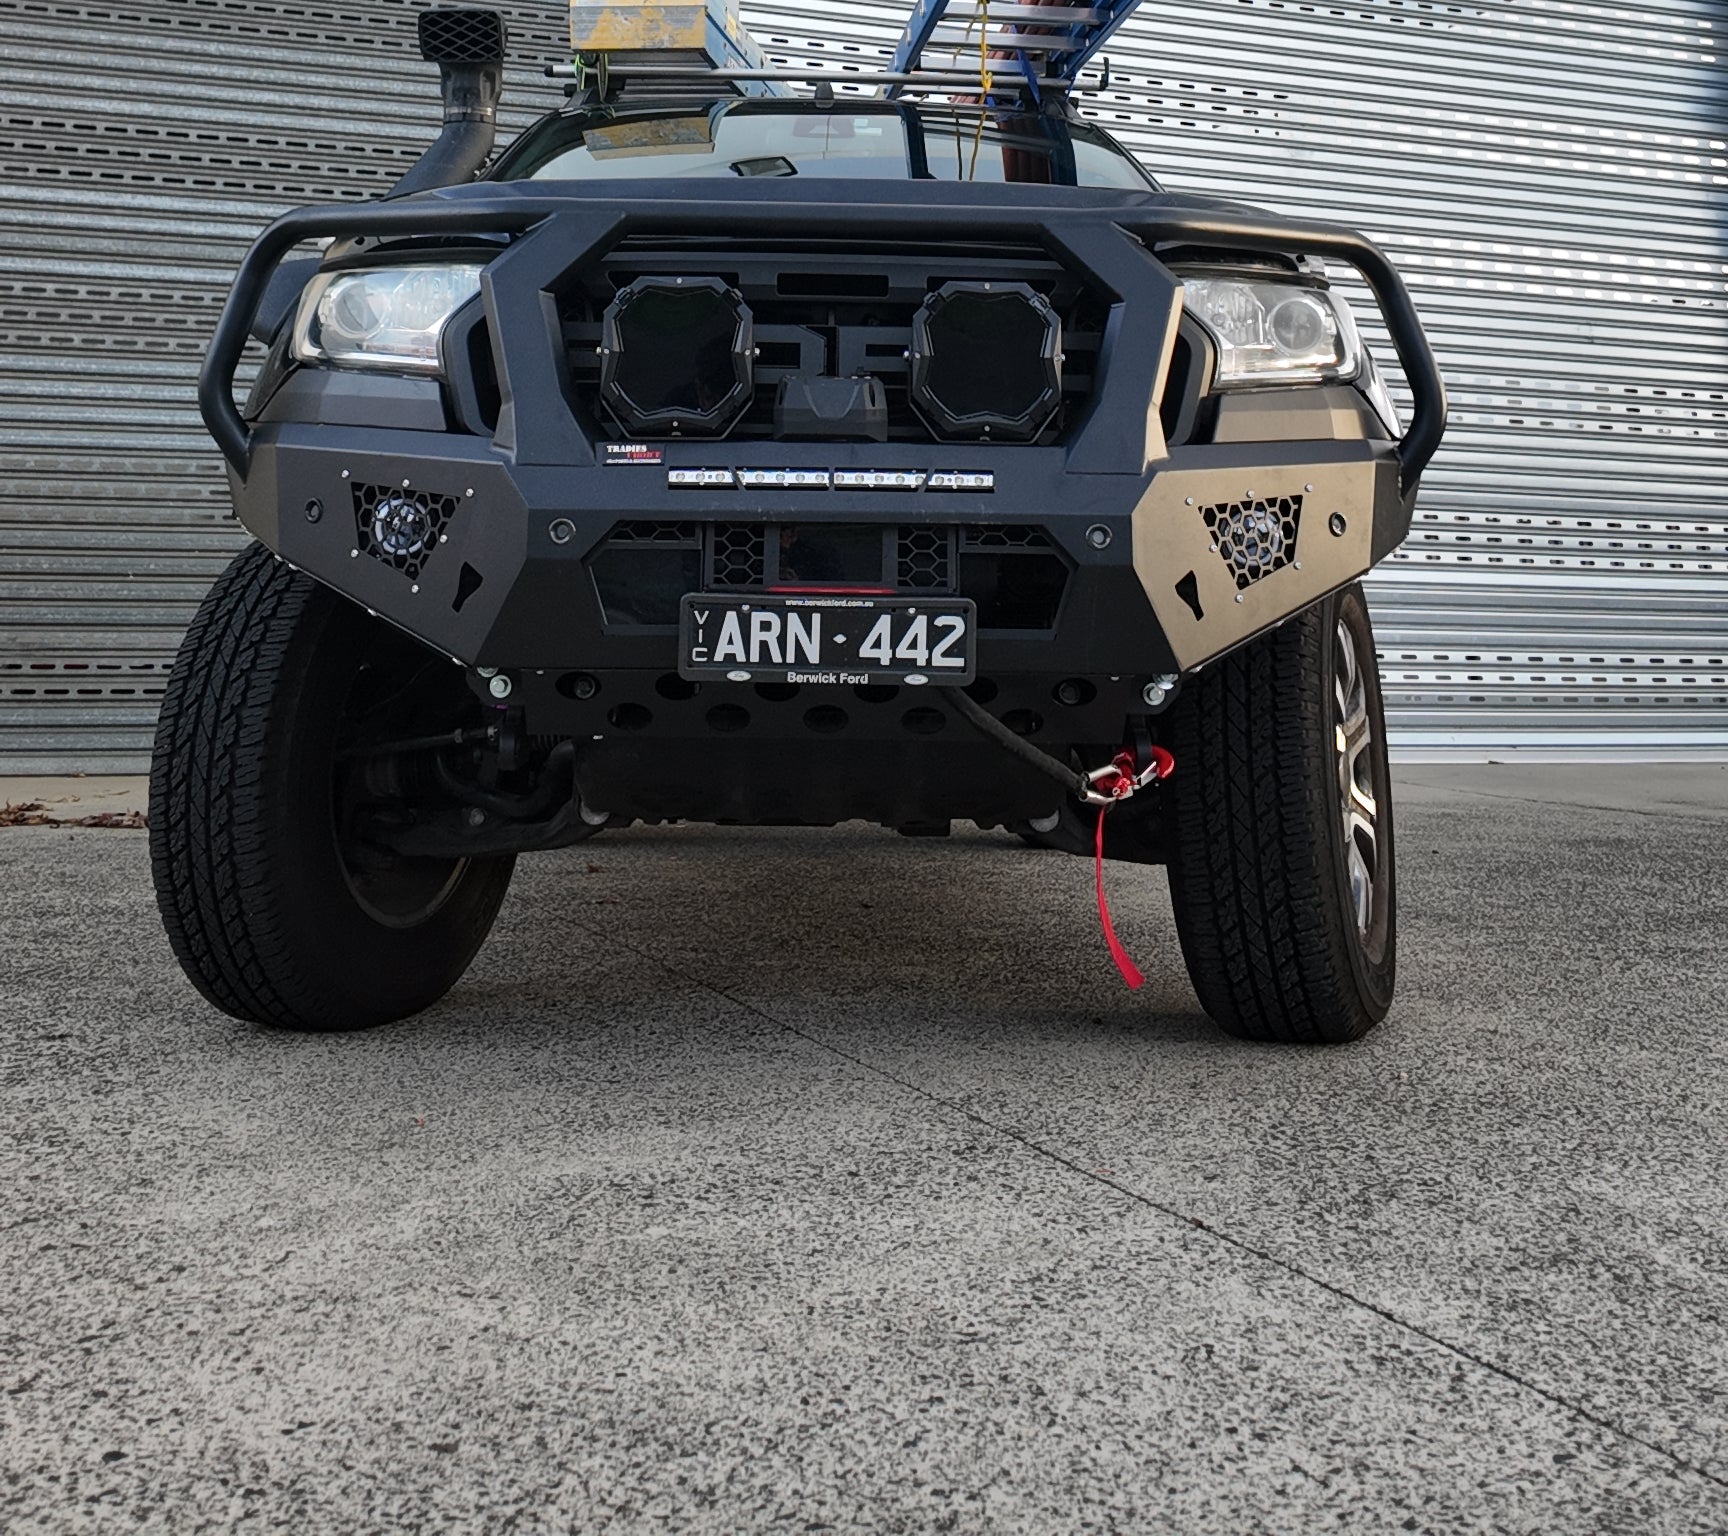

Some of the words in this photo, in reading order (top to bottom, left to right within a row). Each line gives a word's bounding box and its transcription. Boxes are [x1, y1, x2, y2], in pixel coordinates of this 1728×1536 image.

[691, 610, 709, 662] VIC
[713, 611, 821, 664] ARN
[859, 614, 966, 667] 442
[787, 671, 837, 684] Berwick
[839, 672, 869, 685] Ford
